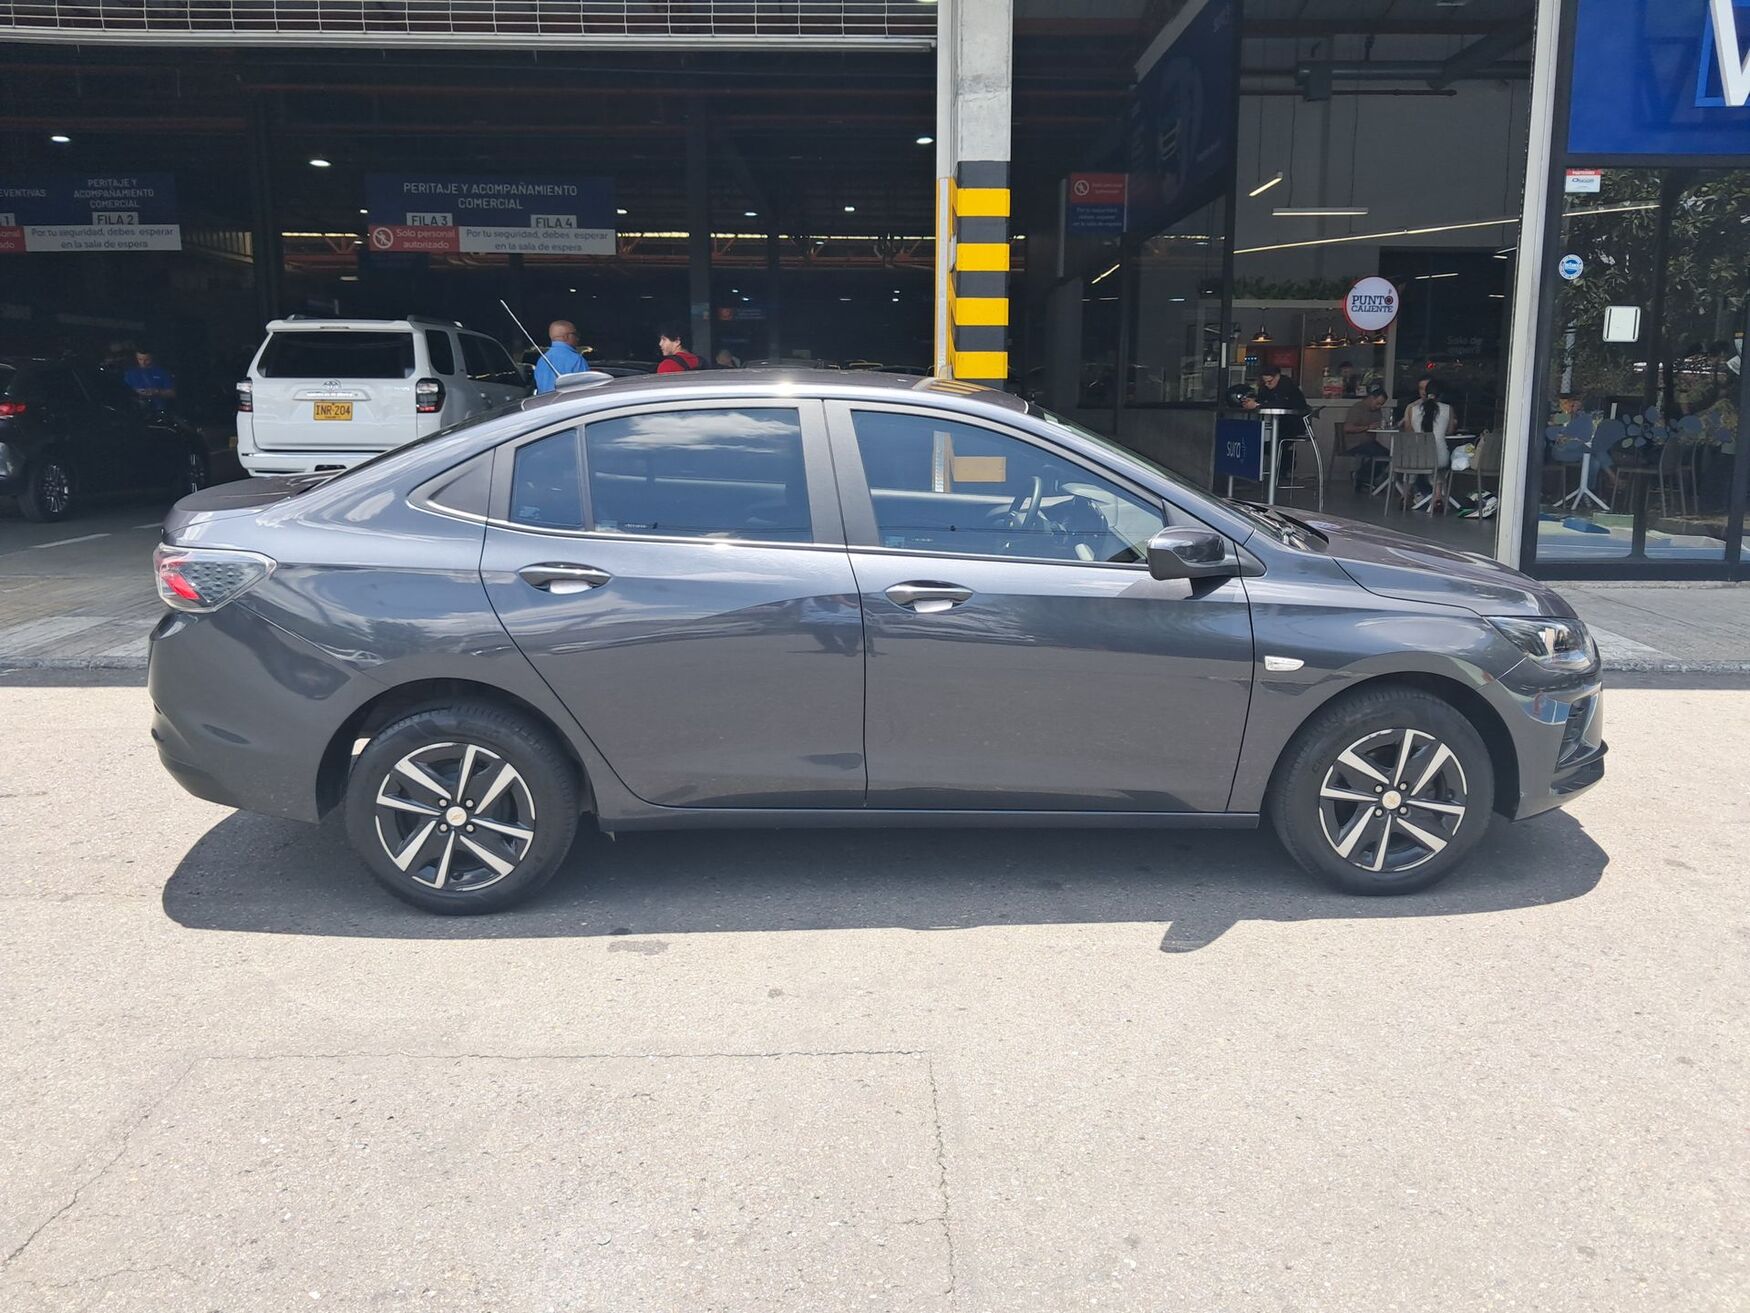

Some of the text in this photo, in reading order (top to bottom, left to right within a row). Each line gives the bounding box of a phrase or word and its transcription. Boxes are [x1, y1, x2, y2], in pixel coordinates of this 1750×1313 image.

[88, 179, 137, 187] PERITAJE Y
[403, 182, 577, 196] PERITAJE Y ACOMPAÑAMIENTO
[89, 199, 140, 209] COMERCIAL
[458, 198, 523, 209] COMERCIAL
[97, 214, 134, 225] FILA 2
[411, 215, 448, 226] FILA 3
[535, 217, 573, 228] FILA 4
[31, 228, 47, 237] Por
[48, 228, 58, 237] tu
[107, 228, 135, 237] debes
[139, 229, 174, 239] esperar
[396, 229, 456, 240] Solo personal
[466, 229, 480, 238] Por
[482, 229, 492, 238] tu
[542, 230, 570, 239] debes
[574, 232, 609, 242] esperar
[60, 239, 149, 251] en la sala de espera
[403, 240, 450, 249] autorizado
[494, 242, 583, 253] en la sala de espera
[1352, 295, 1394, 306] PUNTO
[1351, 305, 1393, 313] CALIENTE
